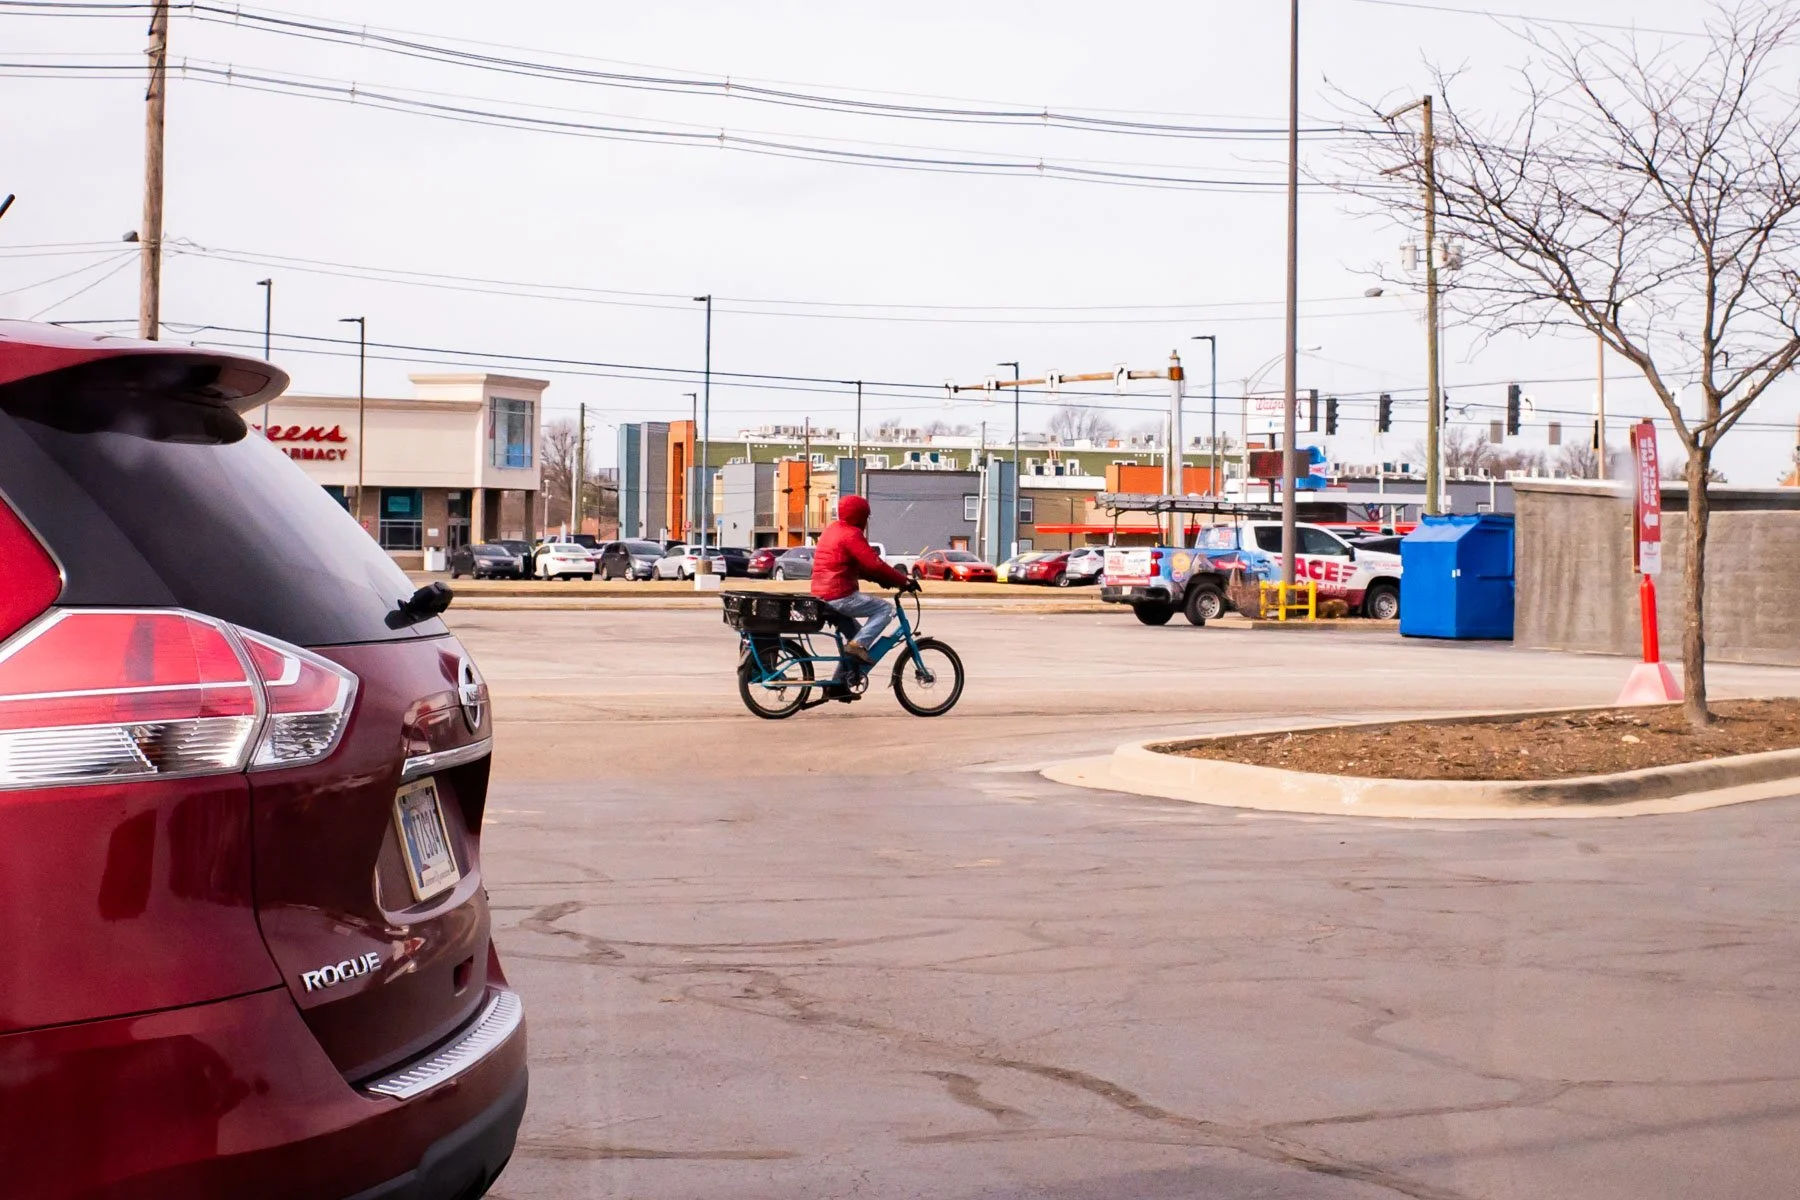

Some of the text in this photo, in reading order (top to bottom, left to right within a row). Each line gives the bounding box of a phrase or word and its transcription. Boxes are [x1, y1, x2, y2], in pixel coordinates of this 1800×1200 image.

[1640, 438, 1649, 504] ONLINE
[1647, 437, 1657, 507] PICK UP
[1295, 556, 1340, 582] ACE
[301, 951, 382, 993] ROGUE
